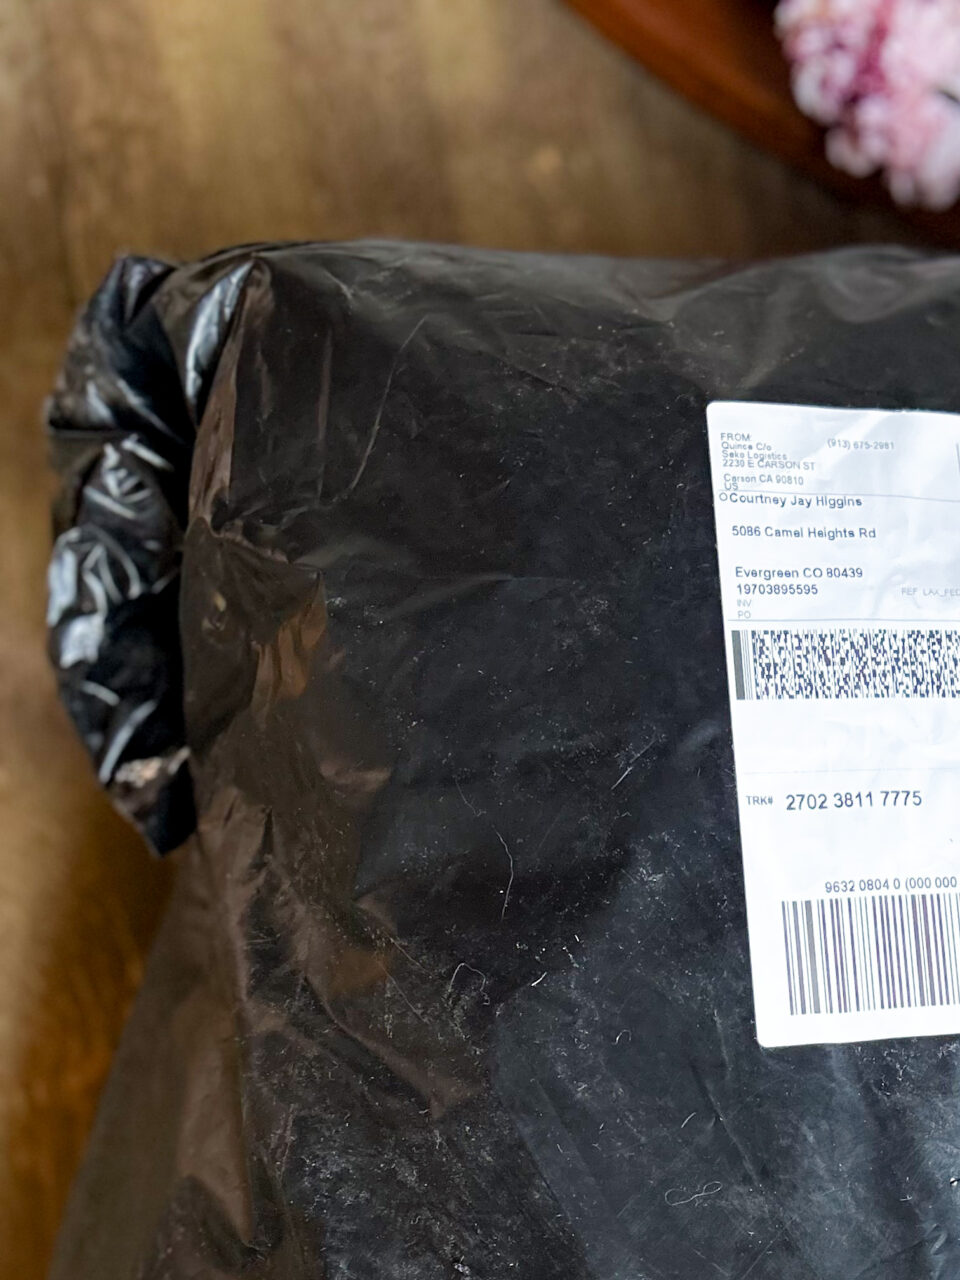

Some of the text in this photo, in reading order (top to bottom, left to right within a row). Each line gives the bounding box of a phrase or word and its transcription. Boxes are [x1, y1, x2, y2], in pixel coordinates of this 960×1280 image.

[722, 442, 753, 451] Quince
[723, 459, 816, 471] 2230 E CARSON ST
[724, 473, 804, 486] Carson CA 90810
[725, 482, 739, 491] US
[729, 493, 787, 508] Courtney
[791, 495, 813, 509] Jay
[816, 495, 863, 509] Higgins
[732, 525, 877, 541] 5086 Camel Heights Rd
[735, 566, 863, 581] Evergreen CO 80439
[737, 584, 819, 595] 19703895595
[746, 790, 923, 811] TRK# 2702 3811 7775
[825, 880, 856, 893] 9632
[858, 878, 890, 891] 0804
[893, 877, 901, 890] 0
[905, 876, 932, 892] (000
[934, 875, 958, 888] 000
